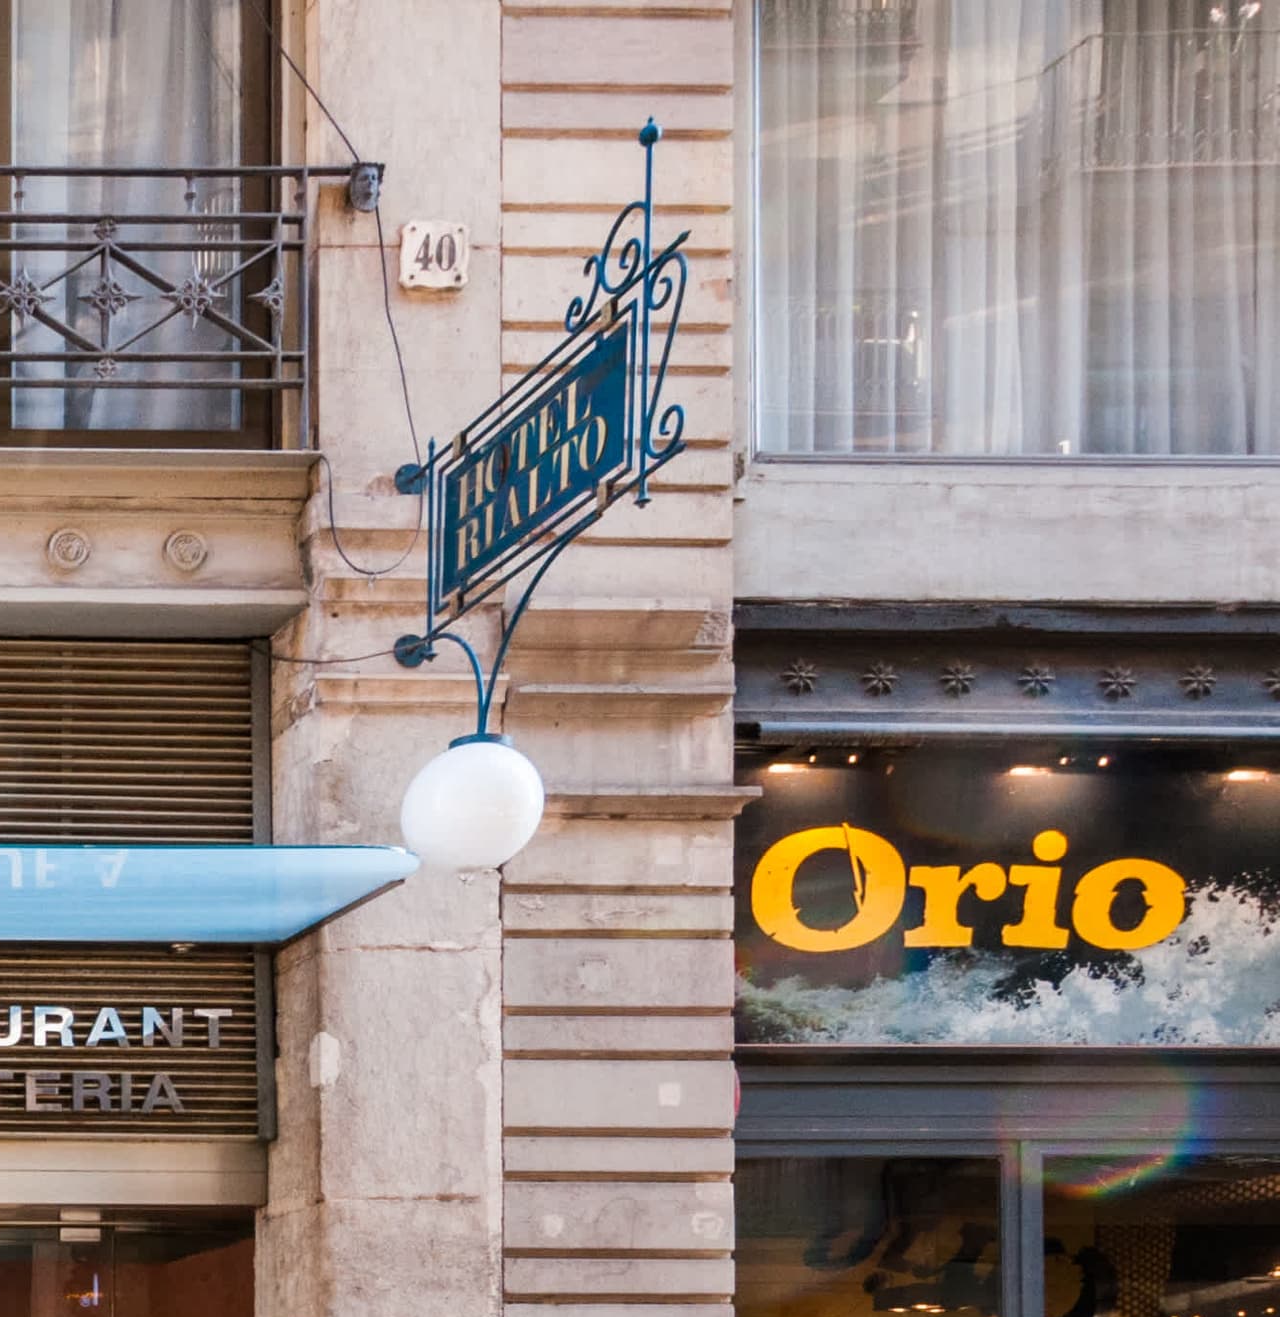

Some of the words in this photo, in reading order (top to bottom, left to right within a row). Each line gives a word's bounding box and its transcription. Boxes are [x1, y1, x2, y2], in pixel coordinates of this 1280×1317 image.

[456, 416, 608, 571] RIALTO
[457, 376, 592, 521] HOTEL
[751, 823, 1186, 953] Orio
